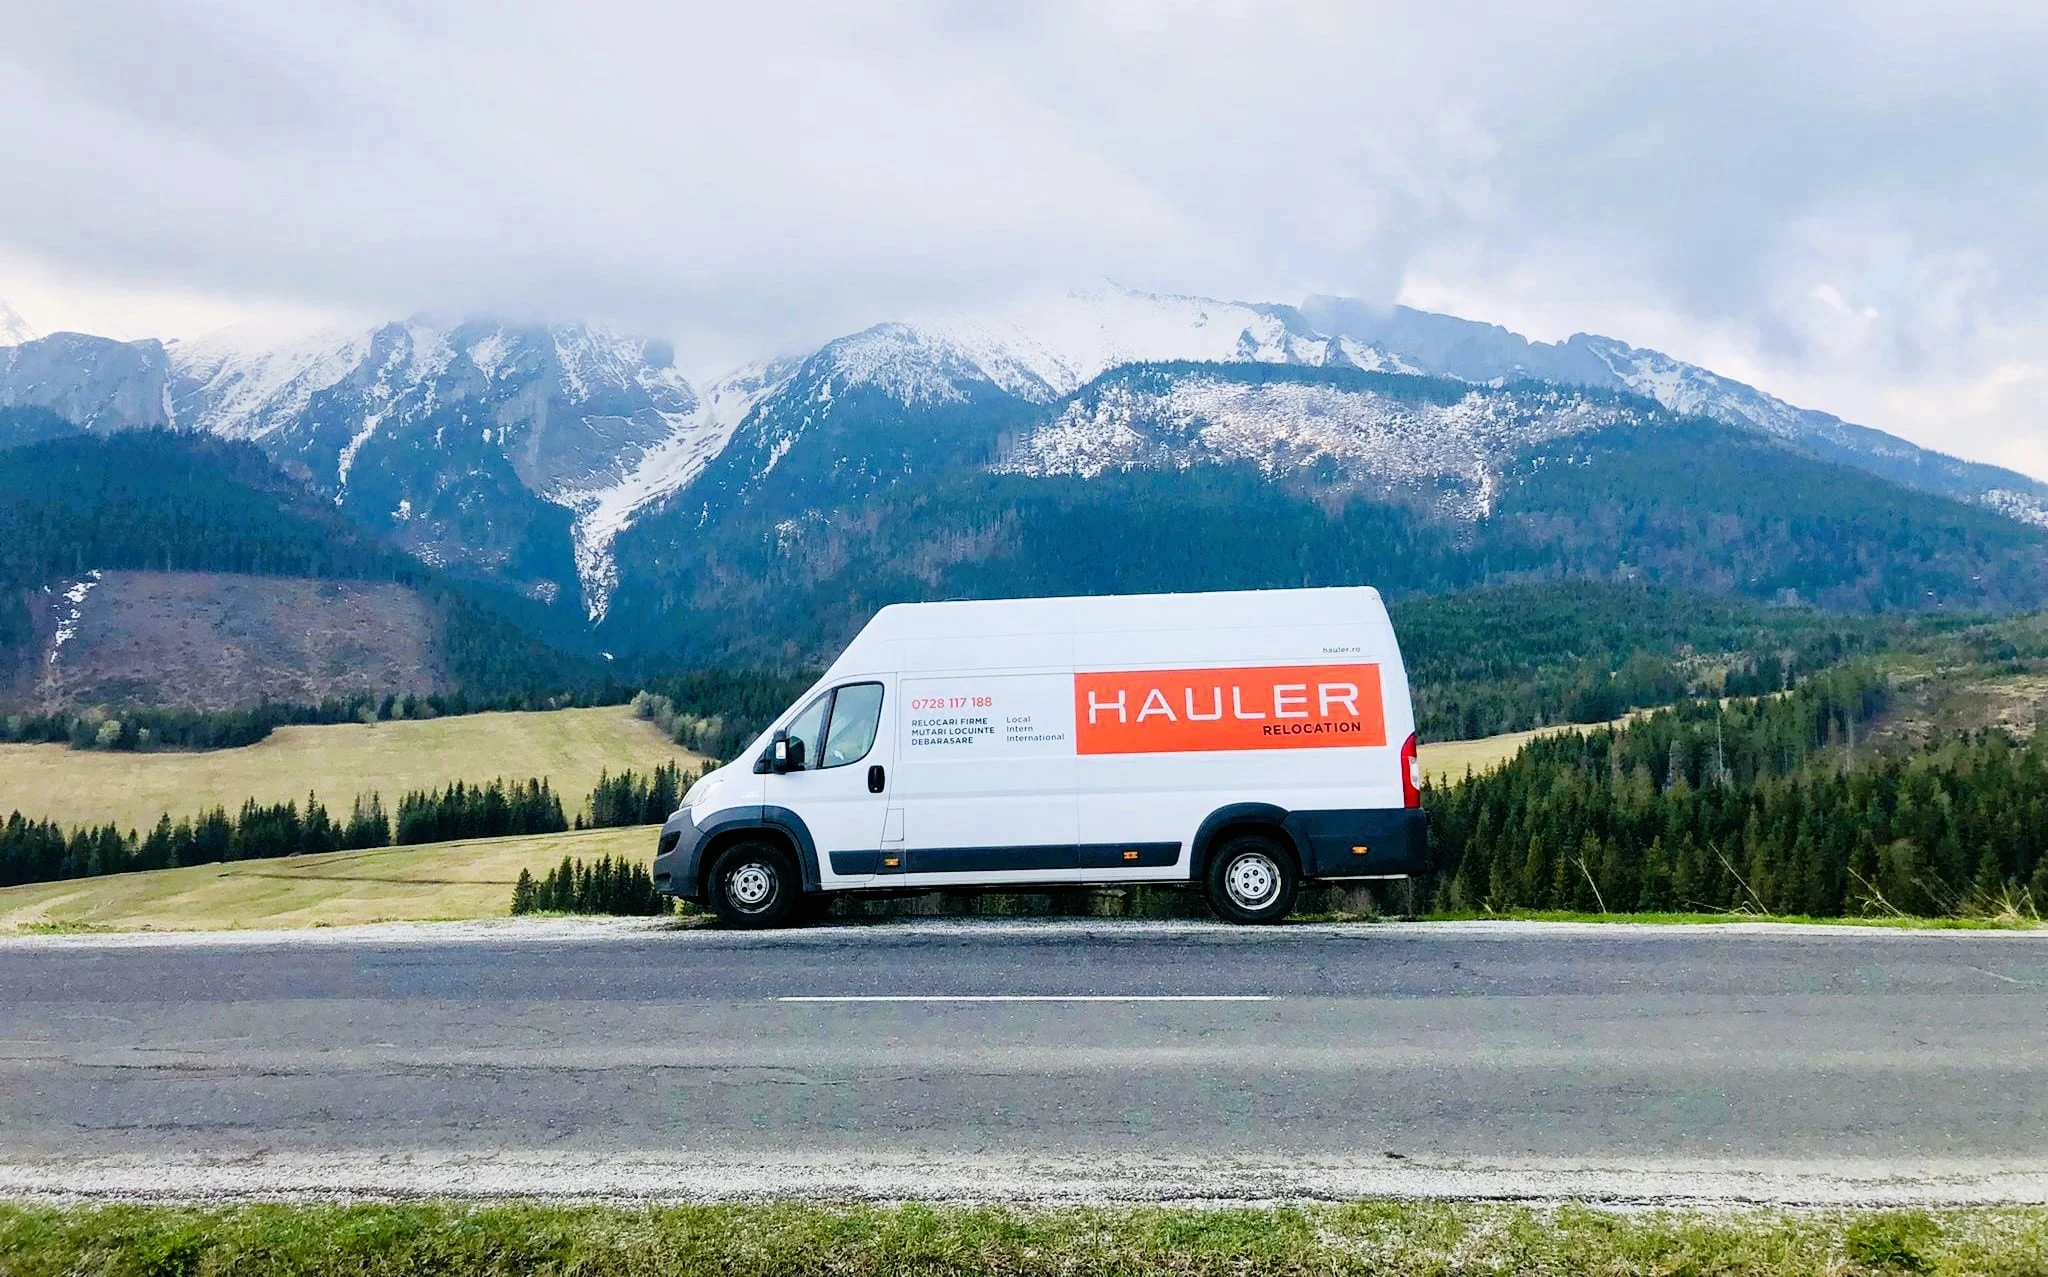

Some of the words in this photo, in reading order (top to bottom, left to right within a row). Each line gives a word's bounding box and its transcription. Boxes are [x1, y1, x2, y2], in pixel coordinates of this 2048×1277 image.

[911, 698, 945, 709] 0728
[949, 697, 967, 708] 117
[972, 696, 993, 708] 188
[1087, 682, 1360, 724] HAULER
[911, 718, 958, 727] RELOCARI
[960, 717, 988, 725] FIRME
[911, 728, 947, 736] MUTARI
[949, 726, 995, 735] LOCUINTE
[1263, 721, 1361, 736] RELOCATION
[911, 737, 974, 746] DEBARASARE
[1006, 733, 1065, 742] International
